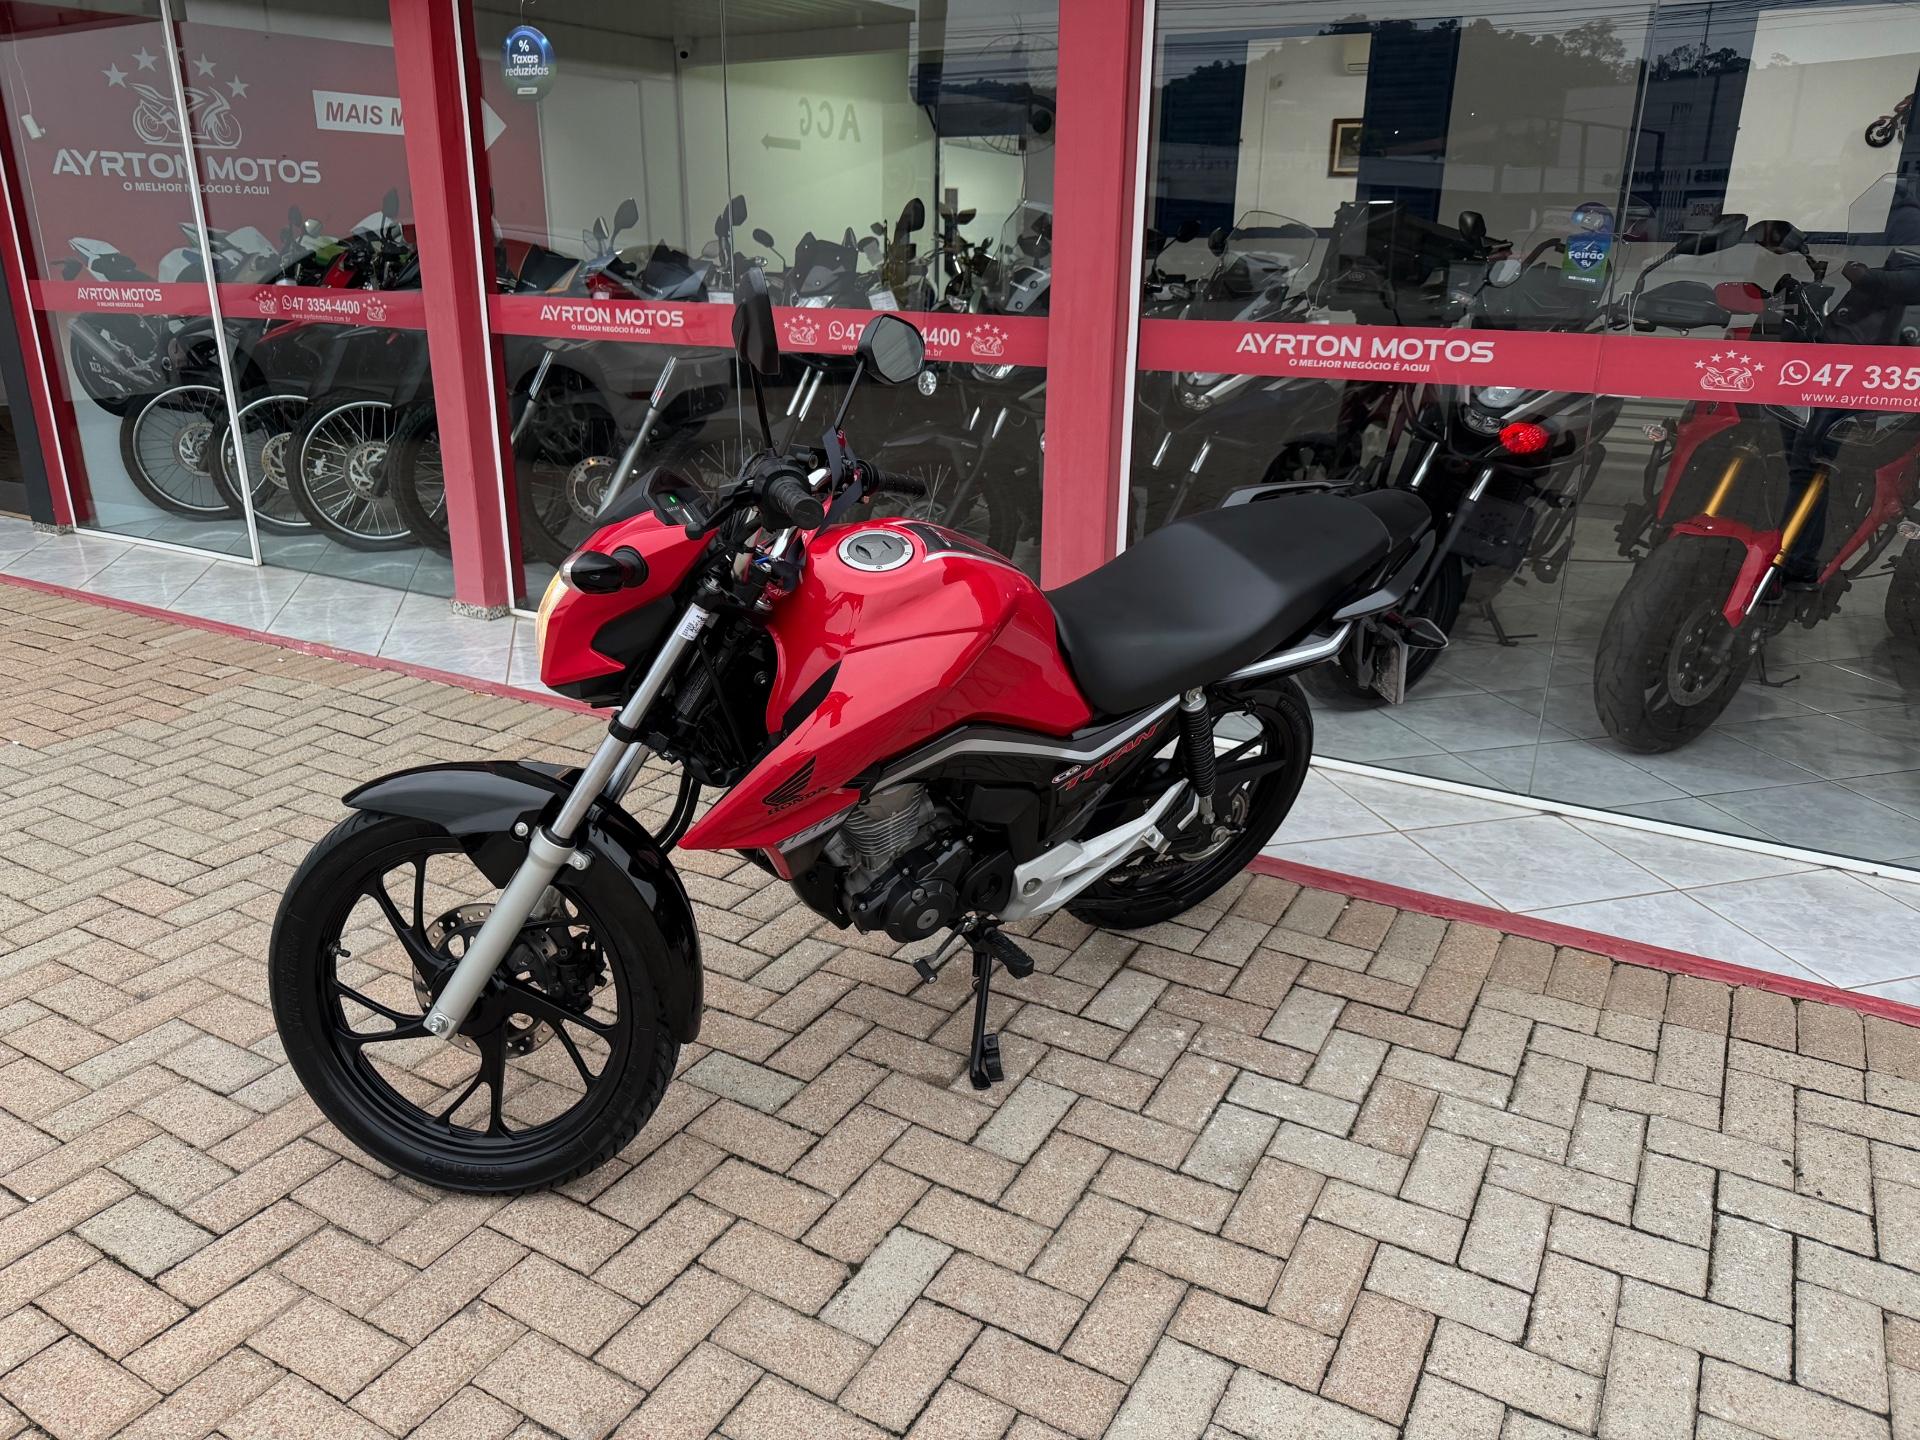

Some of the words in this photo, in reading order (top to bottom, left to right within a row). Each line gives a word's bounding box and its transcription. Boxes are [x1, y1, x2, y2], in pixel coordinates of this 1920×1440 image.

[518, 39, 530, 52] %
[512, 54, 539, 64] Taxas
[505, 64, 549, 77] reduzidas
[325, 101, 383, 125] MAIS
[52, 148, 189, 179] AYRTON
[206, 155, 321, 184] MOTOS
[123, 181, 133, 191] O
[135, 182, 182, 193] MELHOR
[183, 183, 232, 194] NGÓCIO
[235, 183, 242, 194] É
[243, 186, 270, 195] AQUI
[1568, 250, 1605, 260] Feirão
[77, 287, 119, 300] AYRTON
[121, 288, 162, 302] MOTOS
[292, 297, 303, 311] 47
[306, 298, 360, 315] 3354-4400
[540, 304, 611, 324] AYRTON
[615, 308, 684, 328] MOTOS
[602, 325, 629, 334] NEGÓCIO
[845, 323, 866, 341] 47
[1236, 332, 1362, 358] AYRTON
[1370, 337, 1495, 364] MOTOS
[1288, 358, 1297, 367] O
[1298, 359, 1342, 369] MELHOR
[1343, 360, 1392, 371] NEGÓCIO
[1393, 360, 1400, 371] É
[1401, 364, 1430, 373] AQUI
[1812, 363, 1854, 387] 47
[1861, 365, 1920, 391] 335
[1801, 393, 1920, 407] www.ayrtonmot
[767, 786, 830, 816] HONDA
